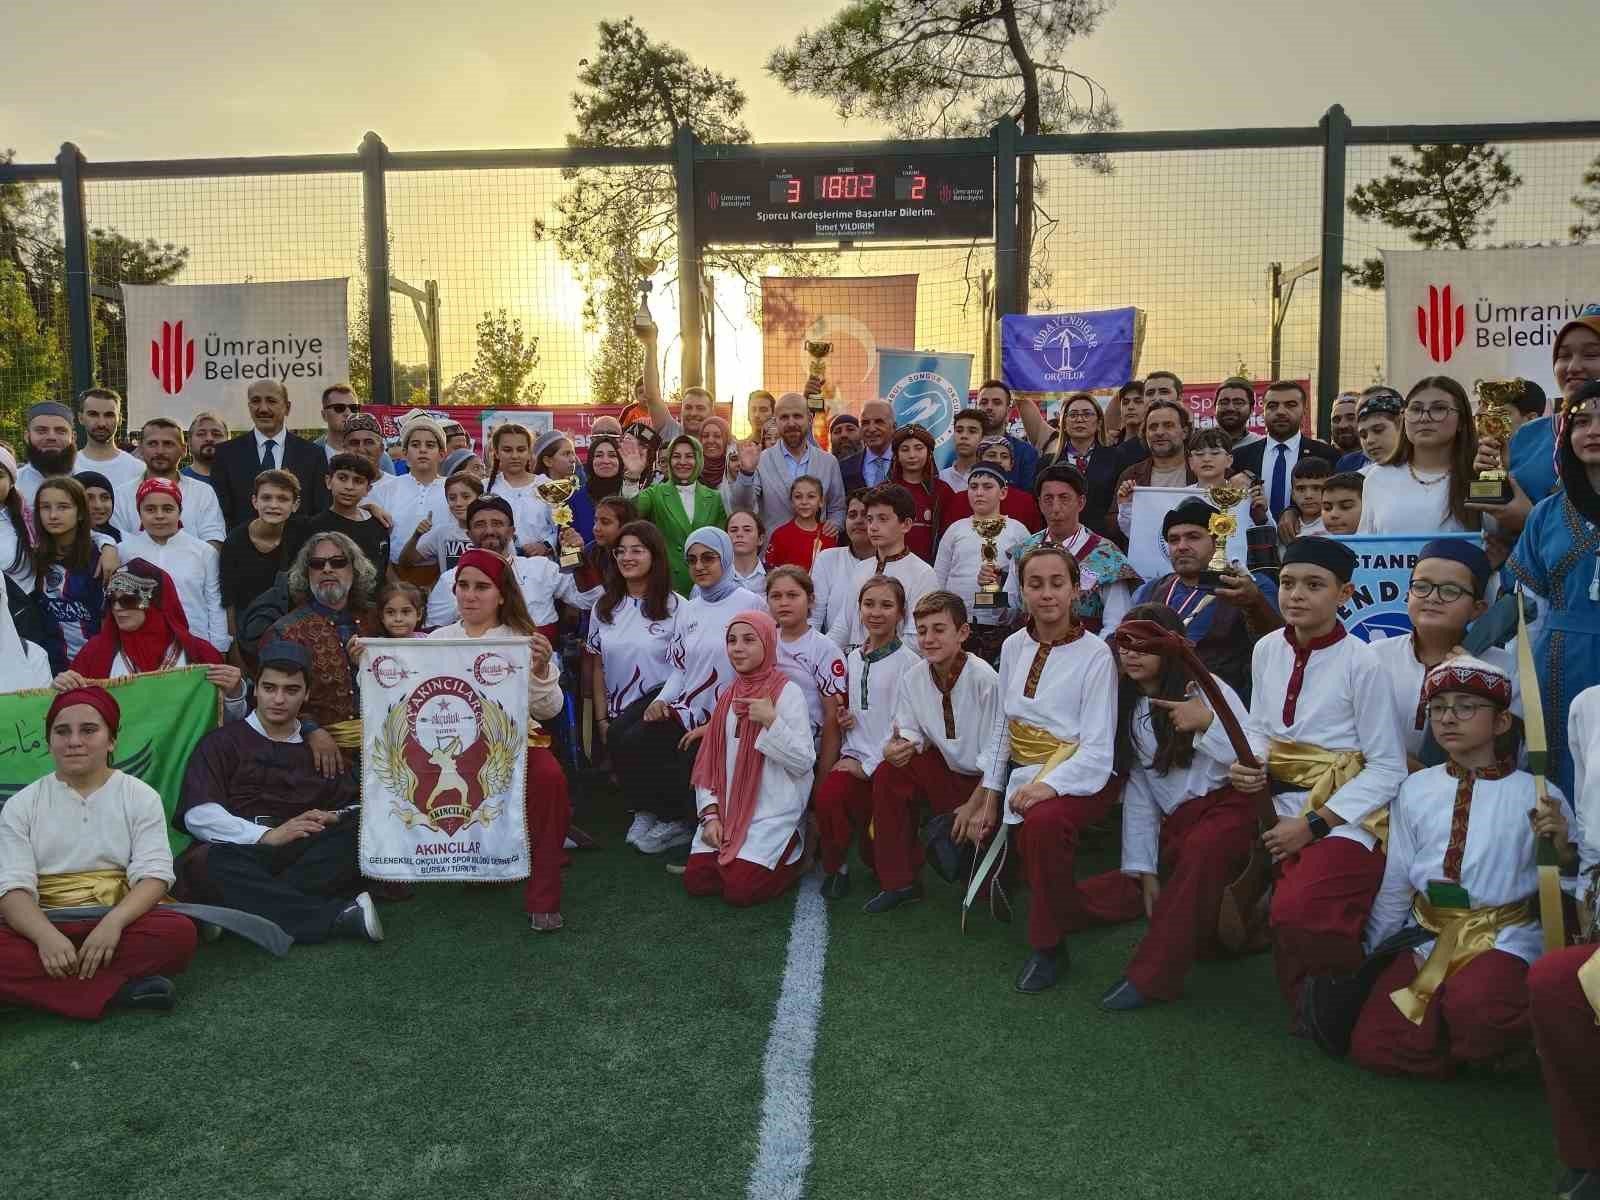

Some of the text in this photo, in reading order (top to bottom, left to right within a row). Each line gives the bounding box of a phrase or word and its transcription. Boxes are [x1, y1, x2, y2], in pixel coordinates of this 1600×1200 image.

[787, 180, 800, 203] 3
[911, 176, 926, 199] 2
[757, 207, 936, 222] Sporcu Kardeşlerime Başarılar Dilerim.
[839, 222, 875, 231] YILDIRIM
[1476, 323, 1559, 348] Beledi
[205, 332, 322, 359] Ümraniye
[205, 356, 323, 382] Belediyesi
[1352, 554, 1418, 569] STANB
[414, 678, 482, 710] AKINCILAR
[416, 841, 481, 855] AKINCILAR
[416, 857, 449, 866] OKÇULUK
[452, 856, 471, 864] SPOR
[420, 865, 446, 873] BURSA
